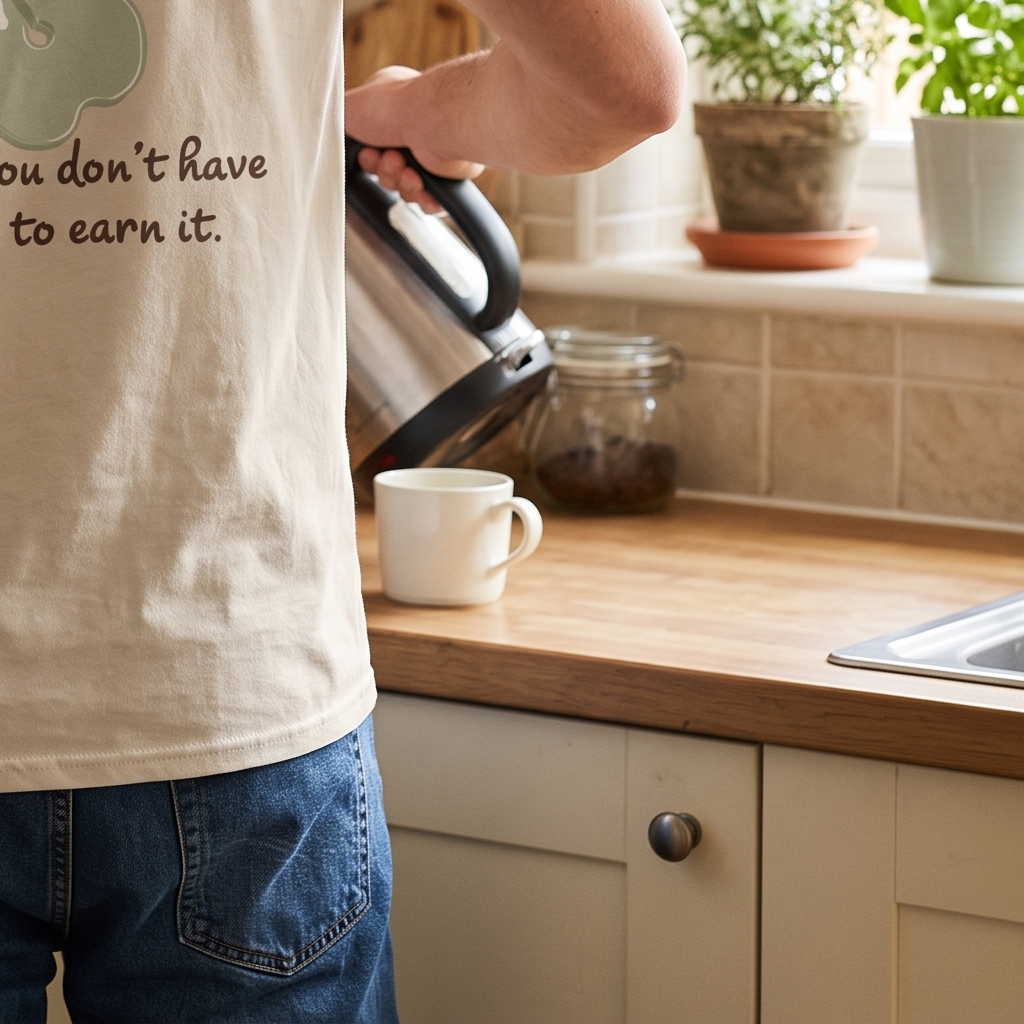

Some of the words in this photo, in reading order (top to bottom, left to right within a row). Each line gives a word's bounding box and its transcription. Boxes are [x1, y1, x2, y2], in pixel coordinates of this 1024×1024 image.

[56, 137, 170, 188] don’t
[179, 135, 268, 181] have
[9, 211, 55, 247] to
[68, 218, 165, 245] earn
[178, 208, 222, 243] it.
